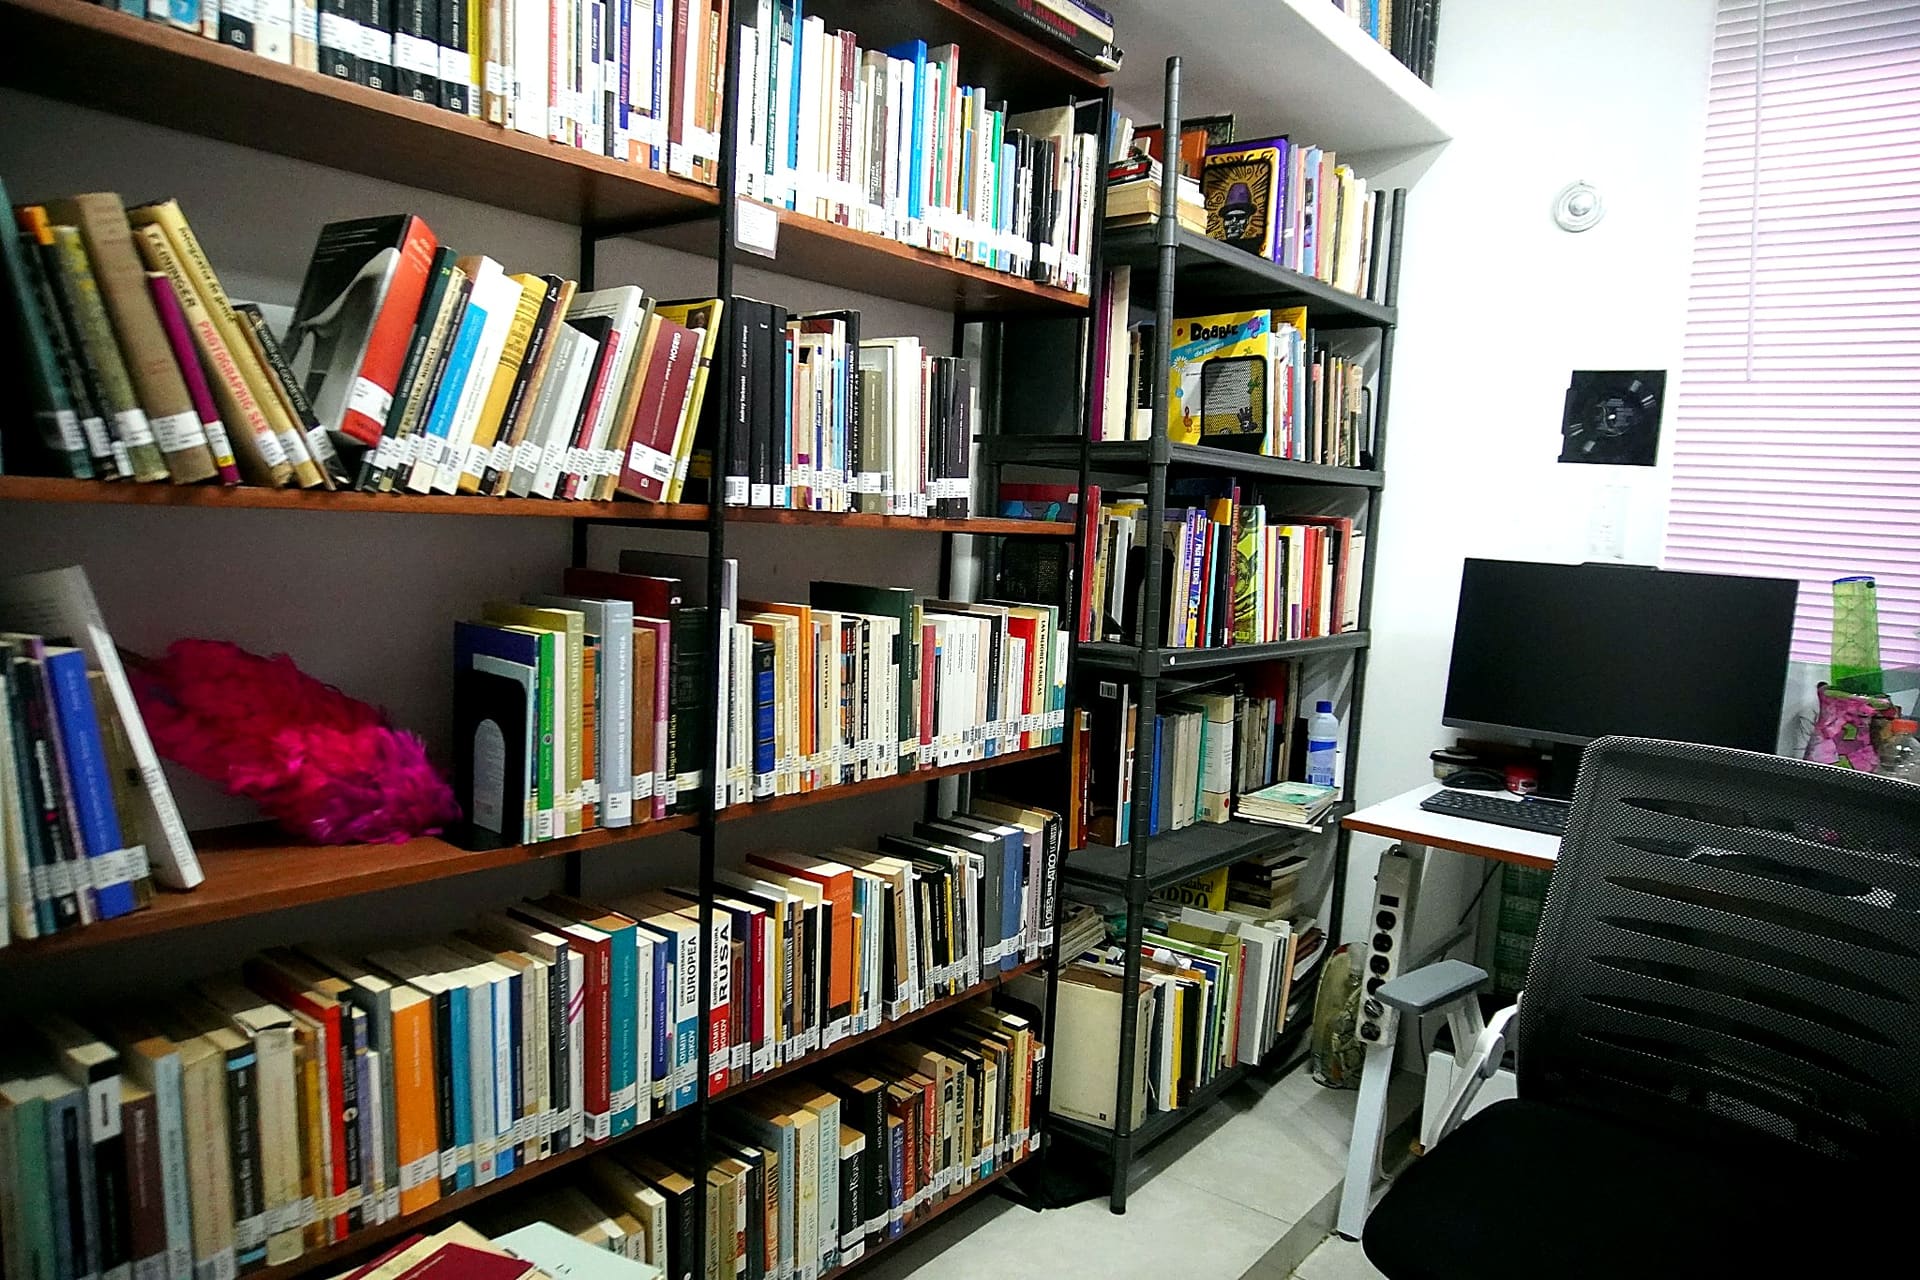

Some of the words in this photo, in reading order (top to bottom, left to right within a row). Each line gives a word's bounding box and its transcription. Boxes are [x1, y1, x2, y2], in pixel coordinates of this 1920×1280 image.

[669, 332, 682, 361] GIBSON
[1190, 323, 1239, 342] DOBBLE
[197, 319, 254, 412] PHOTOGRAPHIC
[668, 751, 677, 778] Elogio
[685, 935, 698, 1004] EUROPEA
[712, 927, 720, 969] LITERATURA
[717, 924, 731, 1001] RUSA
